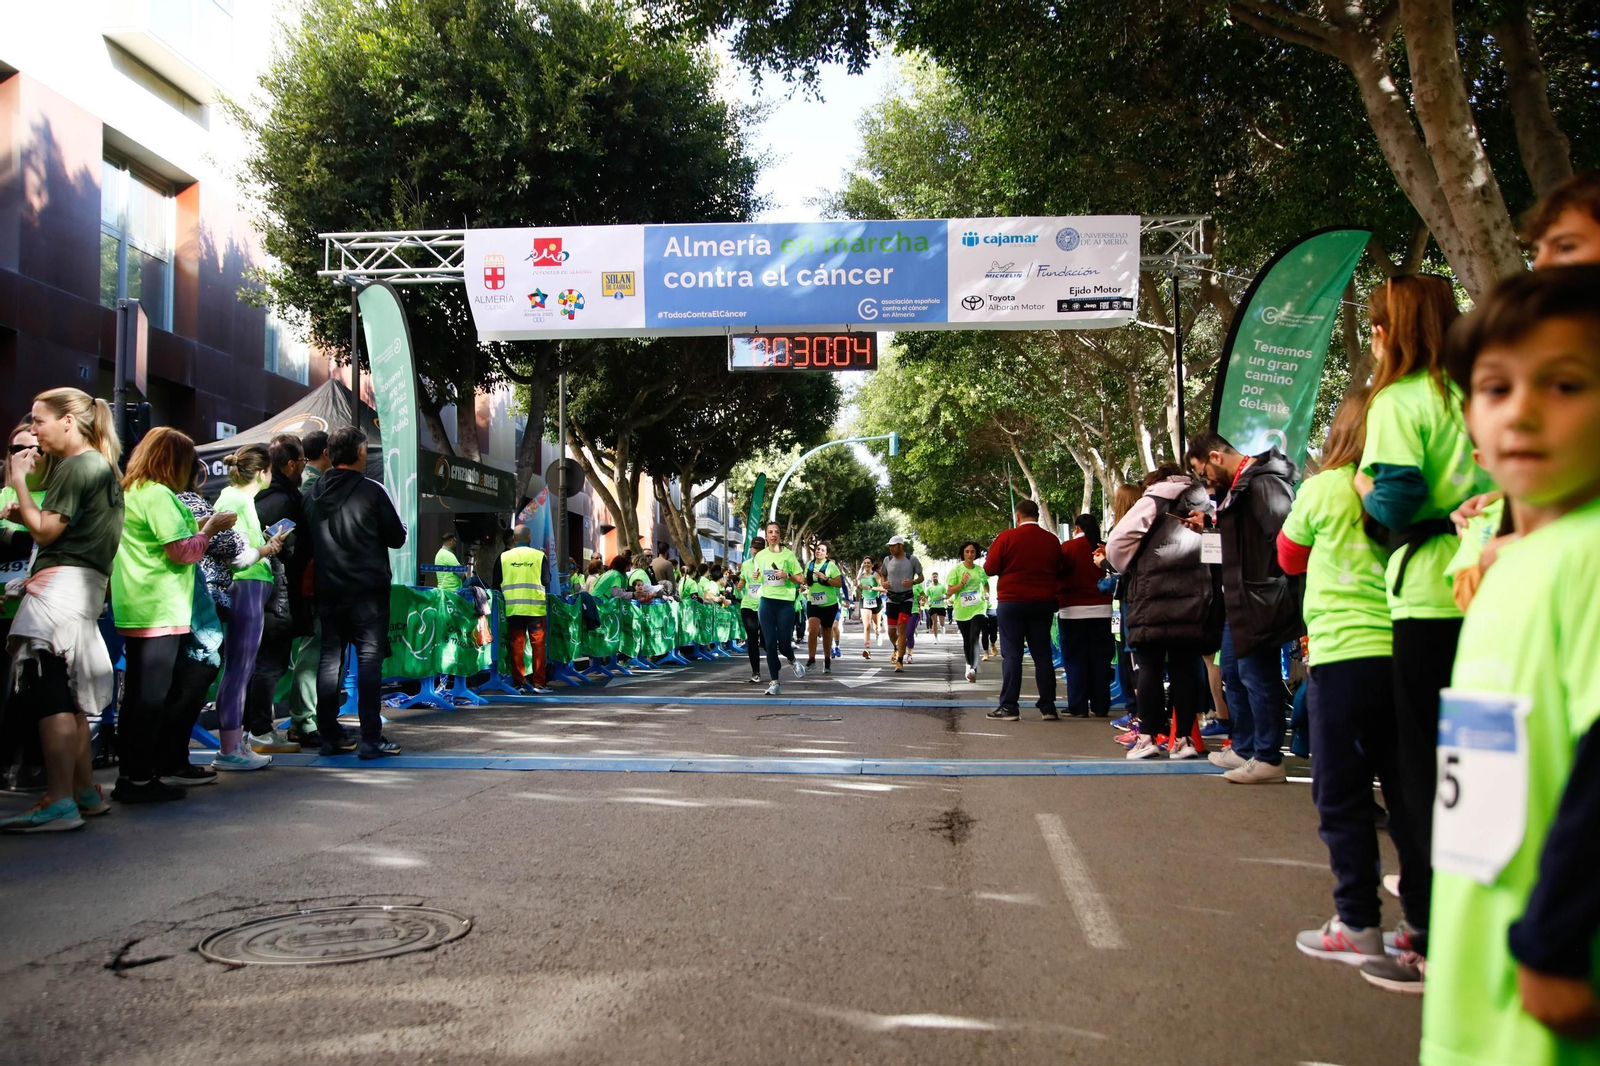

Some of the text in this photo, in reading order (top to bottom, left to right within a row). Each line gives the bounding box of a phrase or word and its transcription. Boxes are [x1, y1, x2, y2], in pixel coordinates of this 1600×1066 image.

[663, 230, 930, 257] Almería en marcha
[983, 233, 1039, 247] cajamar
[663, 263, 894, 288] contra el cáncer
[1036, 264, 1100, 278] Fundación
[1069, 285, 1122, 296] Ejido Motor
[474, 293, 515, 304] ALMERÍA
[989, 294, 1016, 302] Toyota
[988, 302, 1019, 311] Alborán
[657, 309, 747, 319] #TodosContraElCáncer
[752, 336, 871, 367] 00:30:04
[1253, 339, 1313, 359] Tenemos
[1248, 356, 1299, 372] un gran
[1244, 369, 1294, 386] camino
[1241, 384, 1265, 396] por
[1239, 397, 1290, 415] delante
